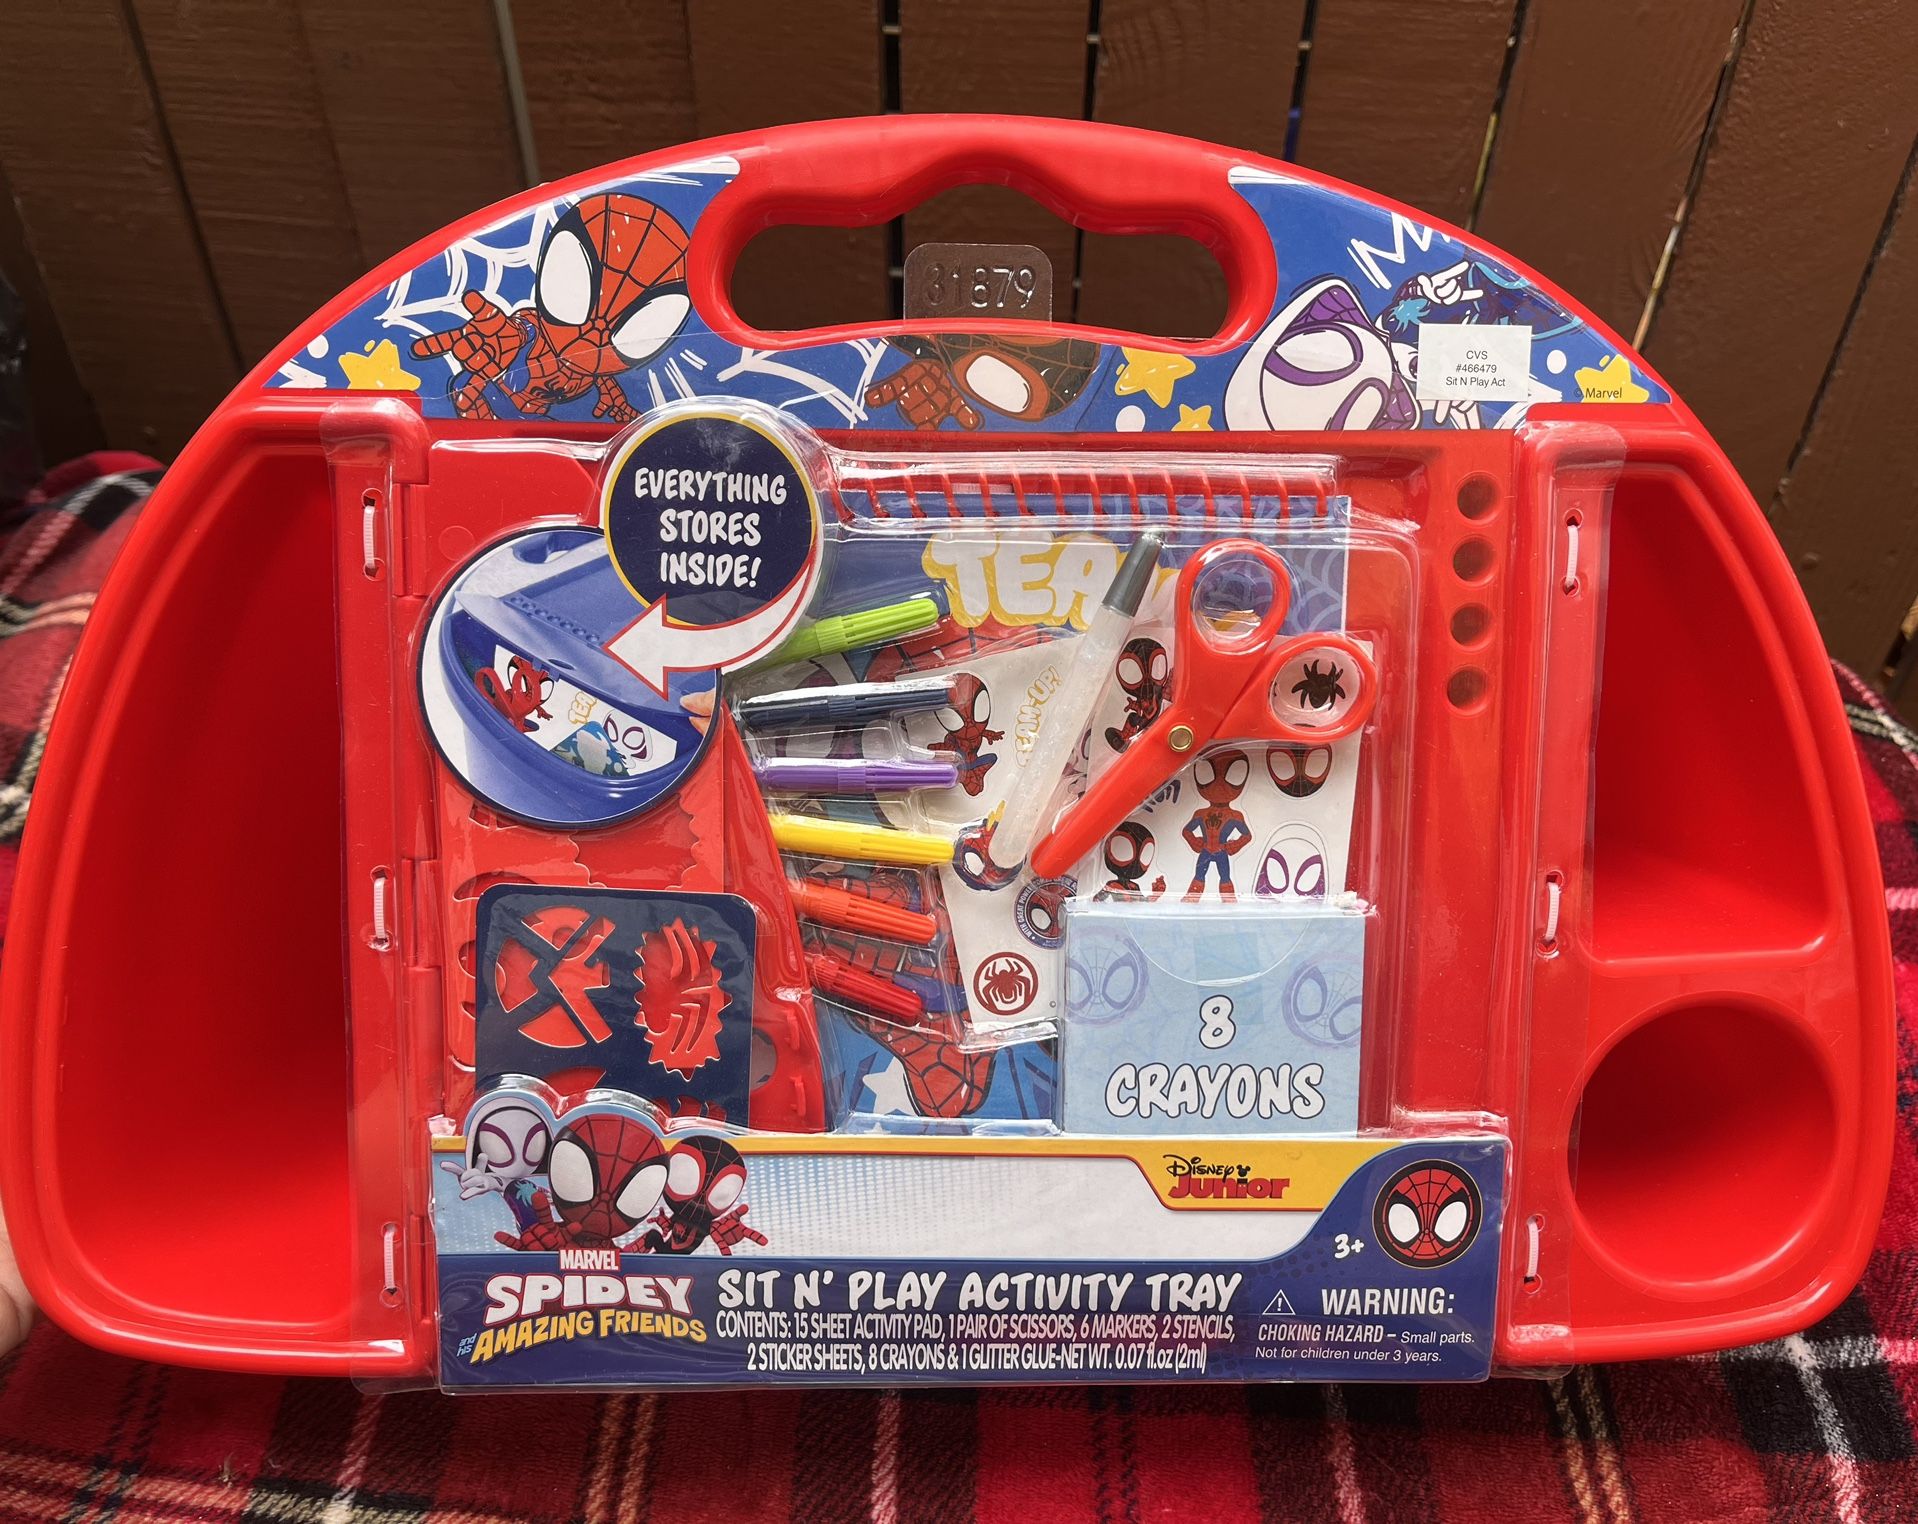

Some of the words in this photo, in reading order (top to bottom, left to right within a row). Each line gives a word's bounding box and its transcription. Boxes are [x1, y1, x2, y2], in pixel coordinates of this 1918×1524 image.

[923, 262, 1037, 309] 31879
[1456, 364, 1498, 374] #466479
[1466, 350, 1488, 360] CVS
[1445, 377, 1458, 387] Sit
[1459, 377, 1468, 387] N
[1470, 377, 1490, 388] Play
[1491, 377, 1506, 387] Act
[1585, 388, 1623, 399] Marvel
[634, 467, 788, 505] EVERYTHING
[659, 508, 762, 547] STORES
[660, 551, 762, 588] INSIDE!
[1199, 994, 1236, 1049] 8
[1105, 1062, 1325, 1119] CRAYONS
[1162, 1154, 1235, 1183] Disney
[1168, 1174, 1290, 1199] Junior
[559, 1250, 619, 1271] MARVEL
[1334, 1233, 1365, 1259] 3+
[485, 1274, 694, 1325] SPIDEY
[717, 1269, 781, 1309] SIT
[793, 1270, 834, 1310] N'
[848, 1270, 947, 1311] PLAY
[958, 1271, 1134, 1312] ACTIVITY
[1145, 1272, 1242, 1313] TRAY
[1321, 1287, 1455, 1316] WARNING:
[459, 1333, 477, 1347] and
[470, 1311, 594, 1364] AMAZING
[600, 1309, 707, 1343] FRIENDS
[716, 1310, 792, 1339] CONTENTS:
[793, 1312, 809, 1339] 15
[810, 1312, 852, 1340] SHEET
[853, 1313, 912, 1340] ACTIVITY
[914, 1313, 944, 1343] PAD,
[949, 1314, 955, 1339] 1
[957, 1314, 988, 1340] PAIR
[989, 1314, 1008, 1340] OF
[1009, 1314, 1077, 1342] SCISSORS,
[1080, 1314, 1090, 1339] 6
[1092, 1314, 1158, 1343] MARKERS,
[1162, 1315, 1171, 1339] 2
[1173, 1314, 1236, 1343] STENCILS,
[1258, 1323, 1322, 1343] CHOKING
[1325, 1324, 1384, 1343] HAZARD
[1400, 1331, 1436, 1344] Small
[1439, 1332, 1475, 1346] parts.
[456, 1344, 473, 1357] his
[747, 1343, 757, 1370] 2
[758, 1342, 812, 1371] STICKER
[813, 1342, 866, 1374] SHEETS,
[868, 1343, 877, 1371] 8
[879, 1343, 944, 1371] CRAYONS
[947, 1343, 959, 1371] &
[961, 1343, 967, 1370] 1
[968, 1343, 1019, 1370] GLITTER
[1088, 1343, 1112, 1370] WT.
[1115, 1343, 1145, 1370] 0.07
[1146, 1341, 1173, 1370] fl.oz
[1174, 1341, 1207, 1374] (2ml)
[1255, 1346, 1278, 1359] Not
[1280, 1347, 1298, 1359] for
[1300, 1347, 1350, 1360] children
[1353, 1349, 1391, 1361] under
[1393, 1350, 1401, 1362] 3
[1404, 1351, 1443, 1364] years.
